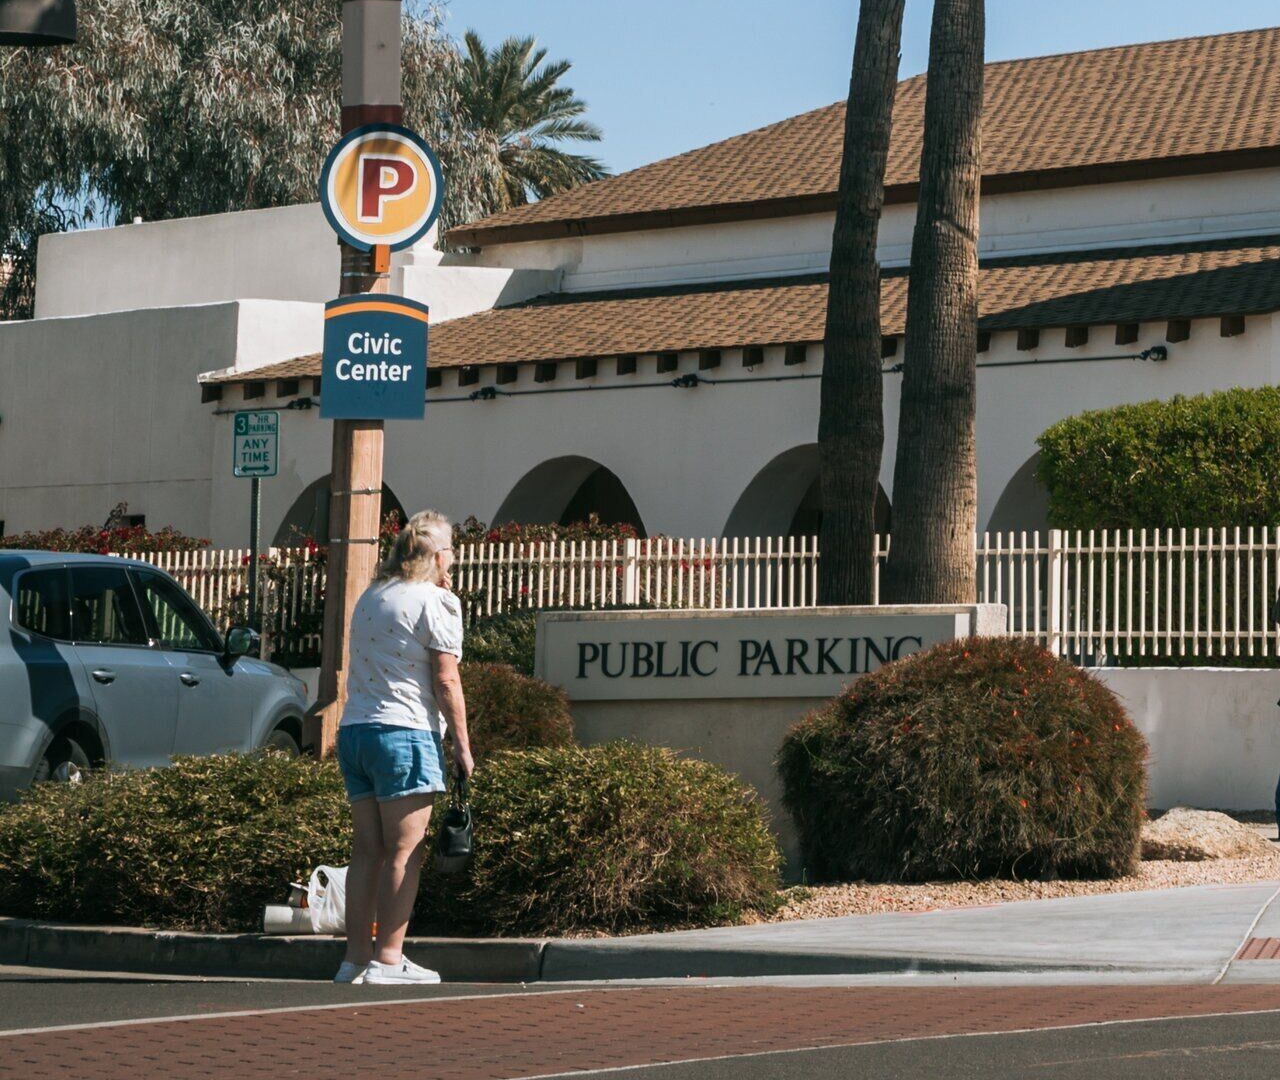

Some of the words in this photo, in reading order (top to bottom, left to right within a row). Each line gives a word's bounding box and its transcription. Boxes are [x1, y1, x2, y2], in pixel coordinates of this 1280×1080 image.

[360, 156, 416, 221] P
[348, 332, 402, 355] Civic
[335, 358, 412, 381] Center
[237, 417, 246, 433] 3
[257, 415, 269, 424] HR
[243, 439, 268, 449] ANY
[241, 451, 269, 462] TIME
[576, 641, 719, 678] PUBLIC
